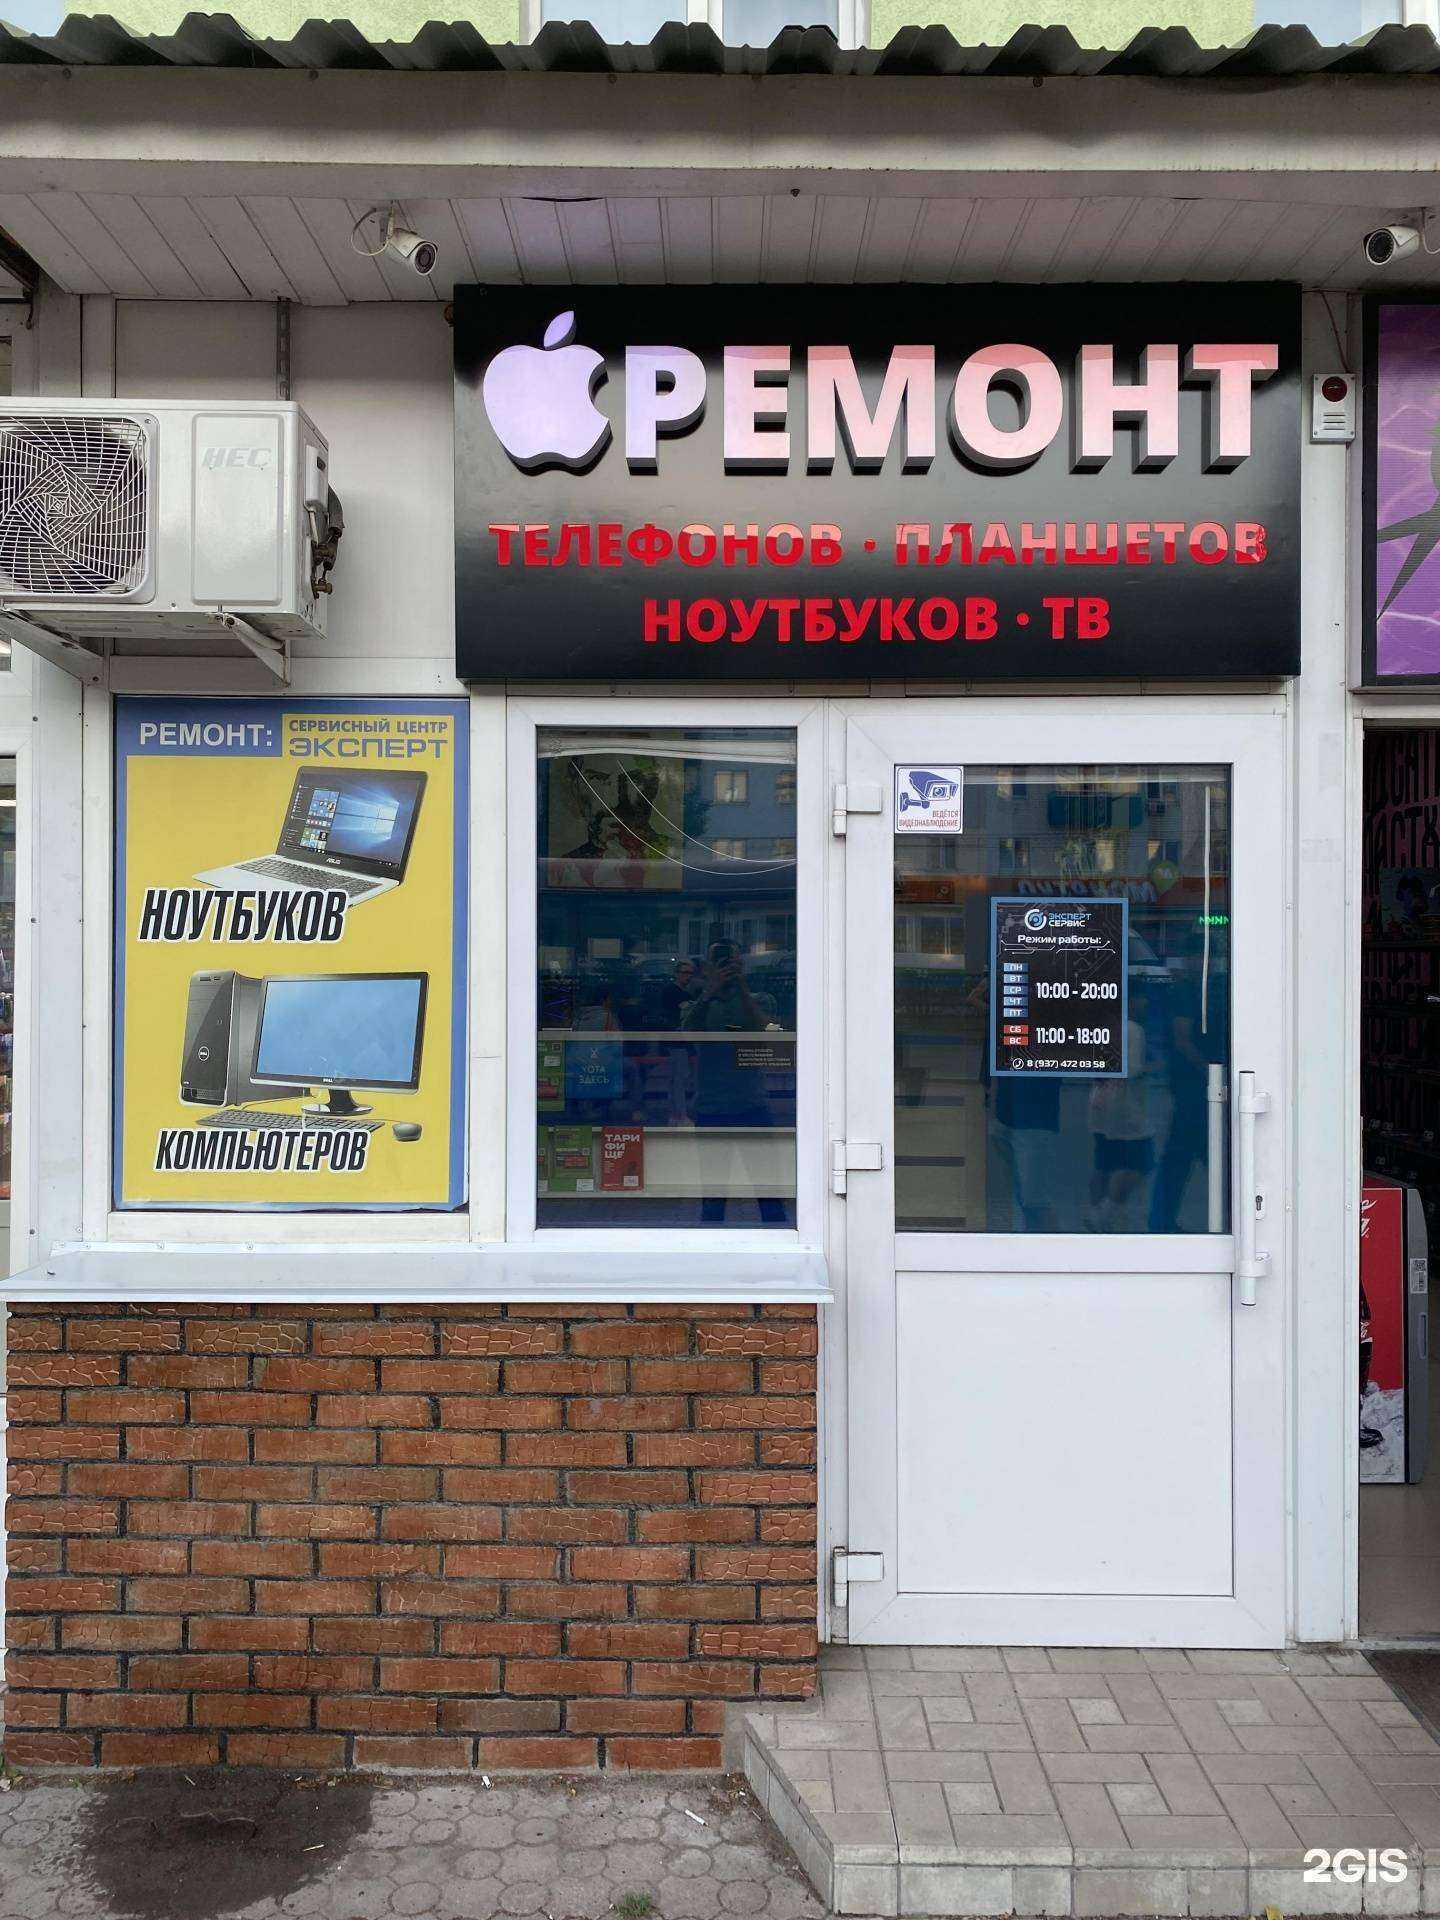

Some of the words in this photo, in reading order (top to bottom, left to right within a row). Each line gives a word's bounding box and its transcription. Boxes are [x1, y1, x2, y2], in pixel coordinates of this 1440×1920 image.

[625, 343, 1279, 474] РЕМОНТ
[489, 522, 843, 566] ТЕЛЕФОНОВ
[895, 521, 1267, 565] ПЛАНШЕТОВ
[643, 596, 998, 642] НОУТБУКОВ
[1042, 596, 1110, 640] ТВ
[139, 722, 273, 747] РЕМОНТ:
[289, 718, 390, 733] СЕРВИСНЫЙ
[397, 721, 448, 735] ЦЕНТР
[289, 737, 448, 759] ЭКСПЕРТ
[139, 888, 348, 942] НОУТБУКОВ
[1048, 913, 1092, 921] ЭКСПЕРТ
[1048, 920, 1086, 928] СЕРВИС
[1017, 935, 1057, 944] Режим
[1058, 935, 1102, 945] работы:
[1009, 963, 1023, 971] ПН
[1009, 986, 1022, 994] СР
[1036, 982, 1070, 999] 10:00
[1080, 983, 1118, 999] 20:00
[1009, 997, 1022, 1005] ЧТ
[1036, 1027, 1066, 1044] 11:00
[1076, 1028, 1110, 1044] 18:00
[1034, 1060, 1059, 1068] (937)
[604, 1134, 640, 1142] ТАРИ
[604, 1142, 626, 1151] ФИ
[155, 1130, 371, 1171] КОМПЬЮТЕРОВ
